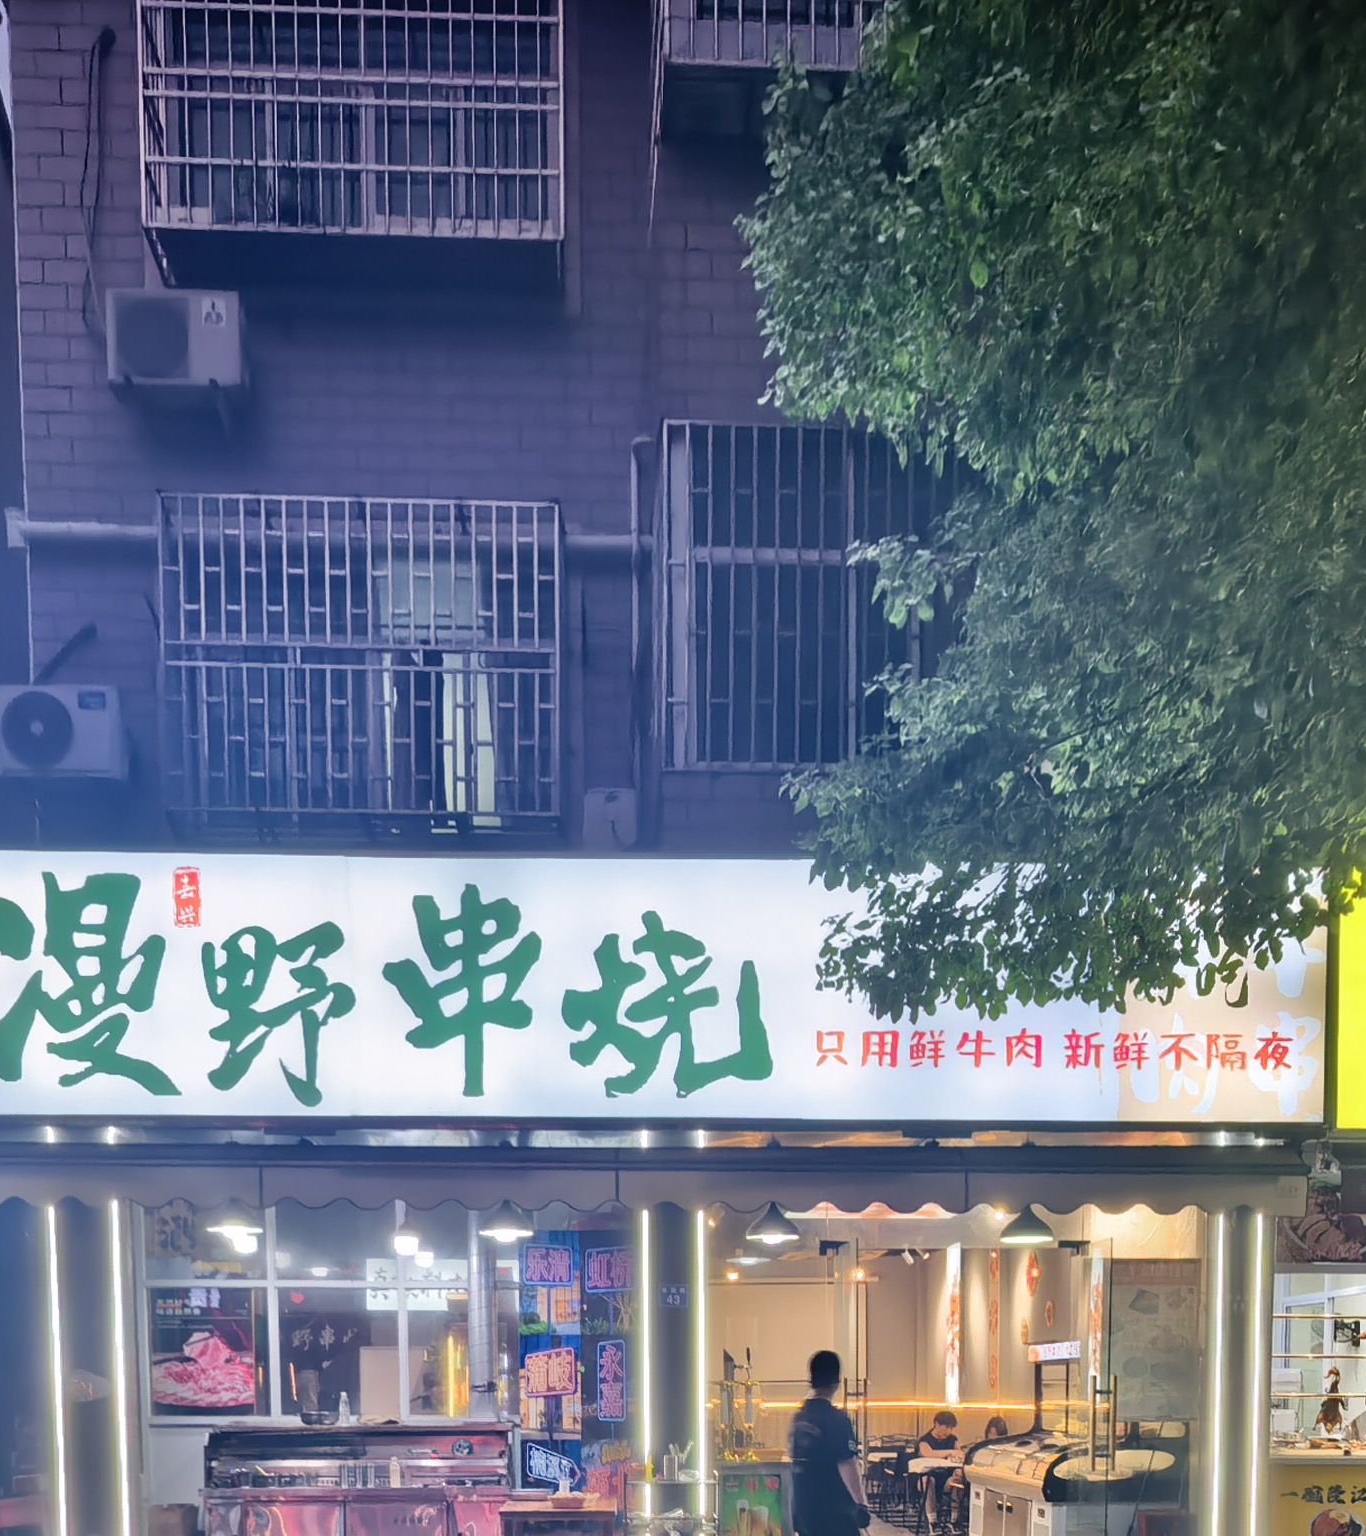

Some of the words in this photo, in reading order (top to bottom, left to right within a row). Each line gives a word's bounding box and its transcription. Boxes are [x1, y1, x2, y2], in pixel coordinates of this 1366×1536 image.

[815, 1029, 1044, 1070] 只用鲜牛肉
[1064, 1029, 1295, 1072] 新鲜不隔夜
